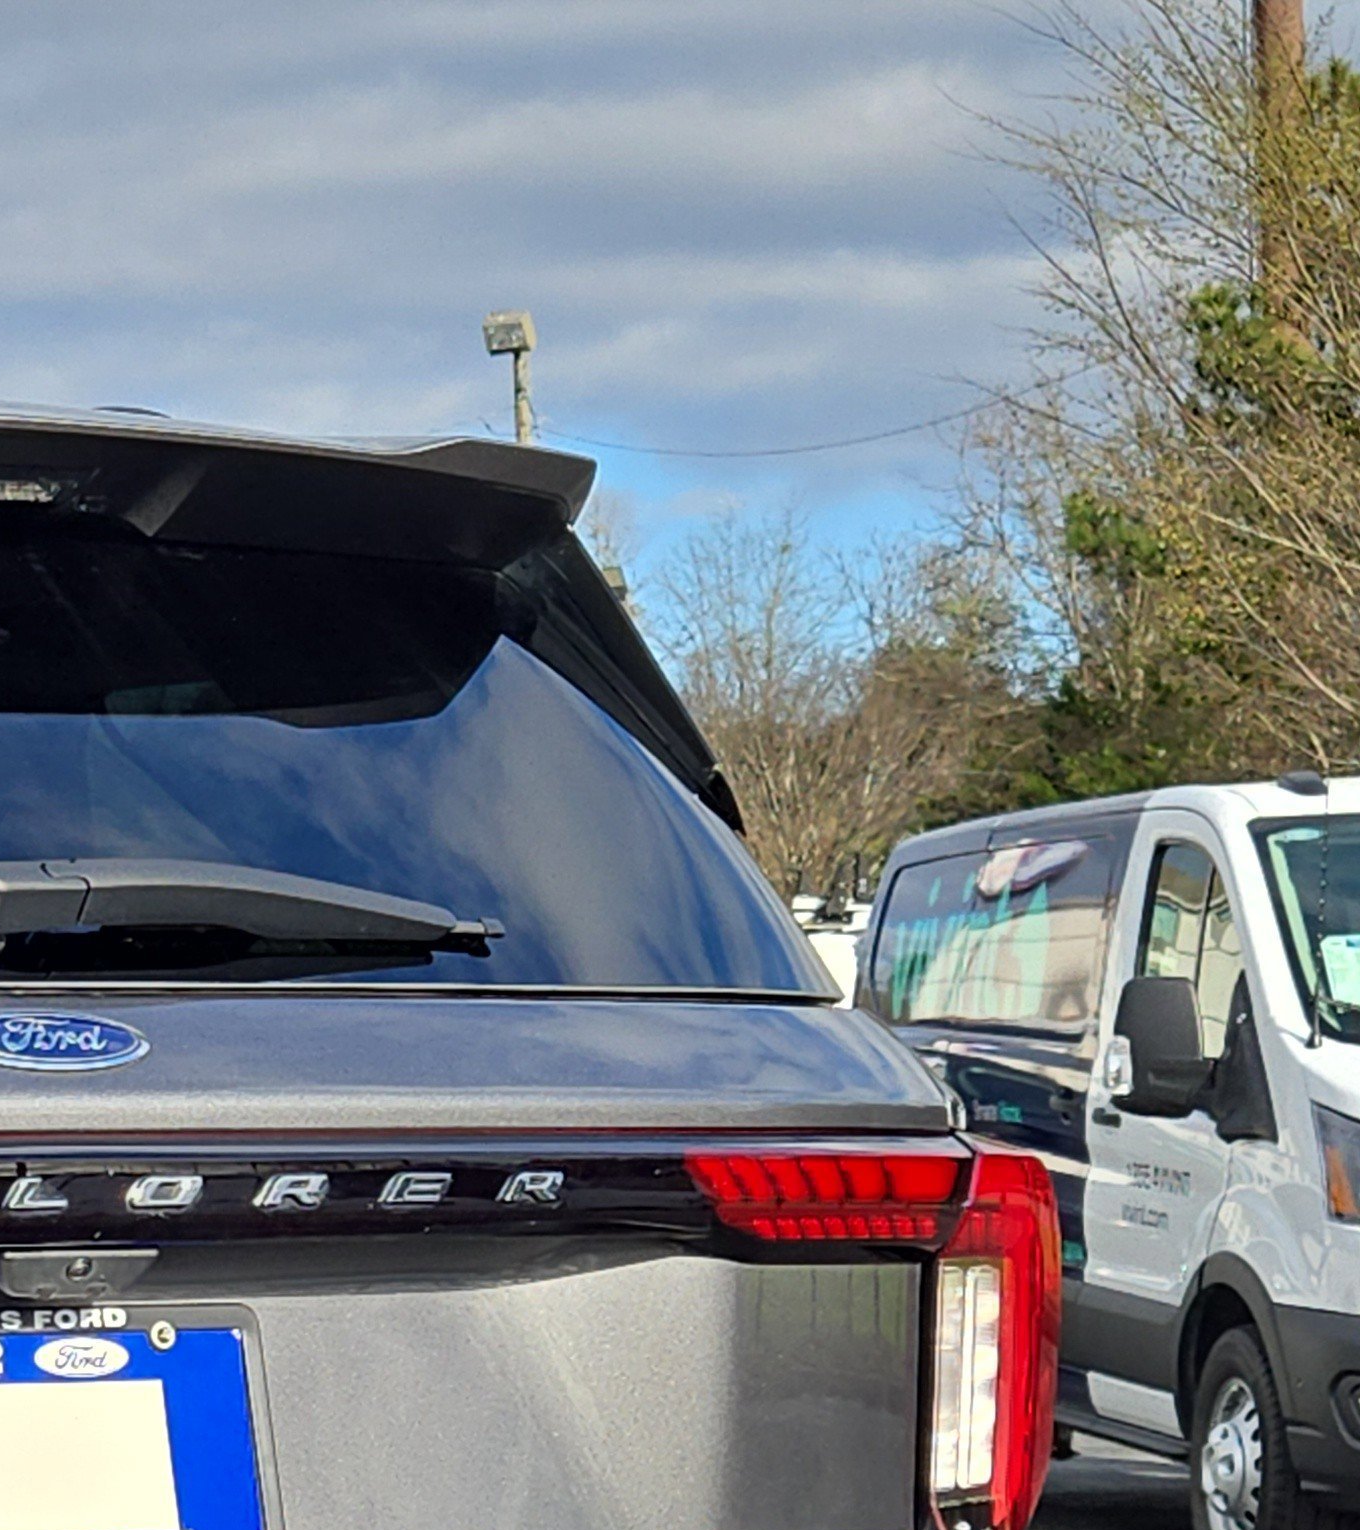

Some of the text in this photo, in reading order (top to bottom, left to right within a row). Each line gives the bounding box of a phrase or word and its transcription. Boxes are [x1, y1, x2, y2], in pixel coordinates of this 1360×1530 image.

[1, 1016, 108, 1052] Ford
[34, 1308, 127, 1330] FORD
[55, 1345, 107, 1369] Ford
